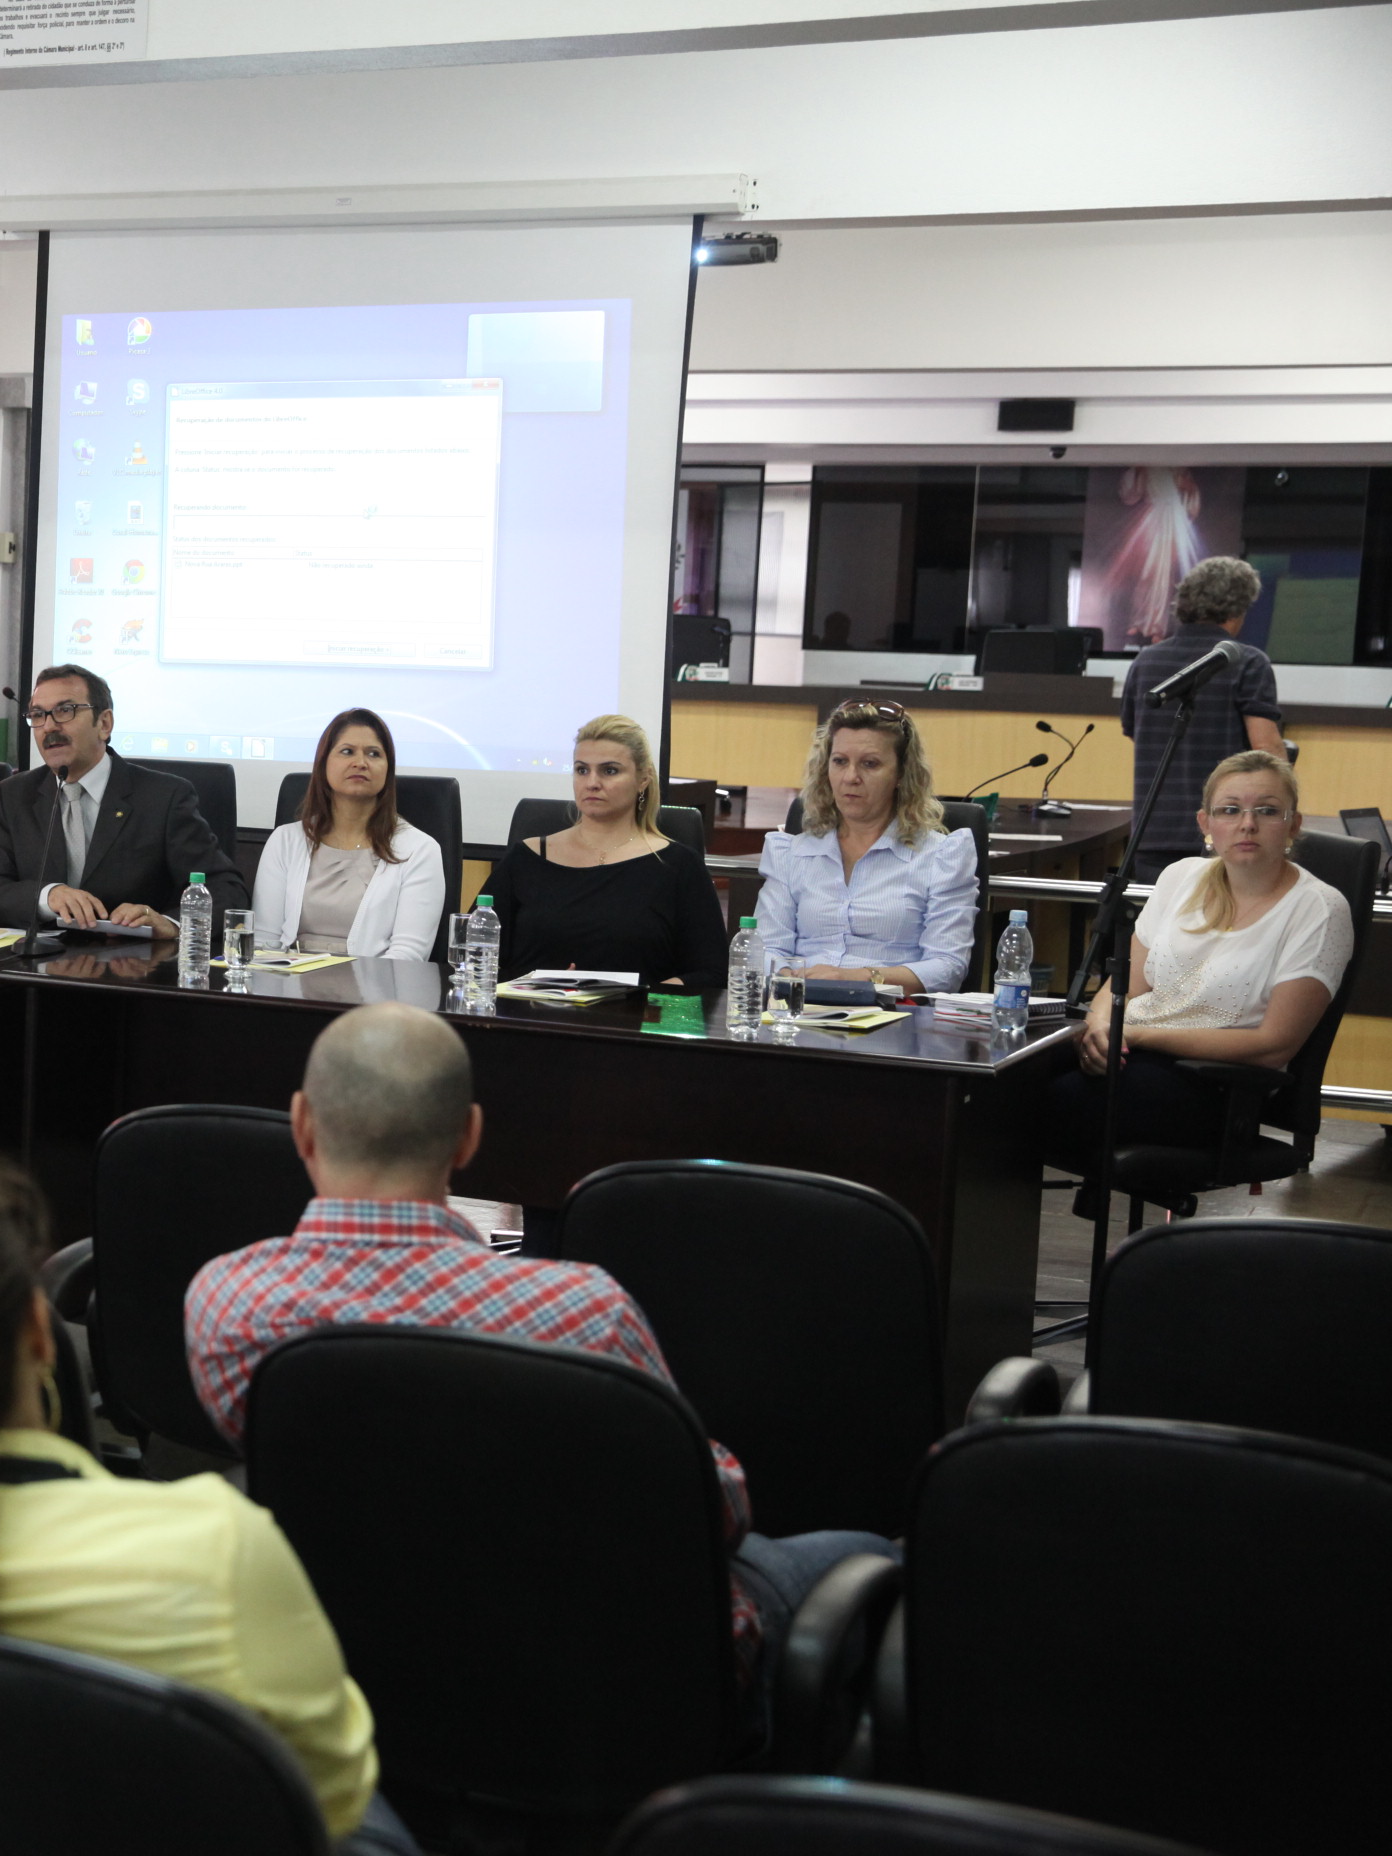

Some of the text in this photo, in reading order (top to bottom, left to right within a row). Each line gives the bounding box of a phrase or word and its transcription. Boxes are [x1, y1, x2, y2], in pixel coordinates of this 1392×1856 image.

[58, 45, 74, 53] Municipal
[176, 416, 215, 424] Recuperação
[224, 416, 262, 424] documentos
[440, 647, 466, 655] Cancelar
